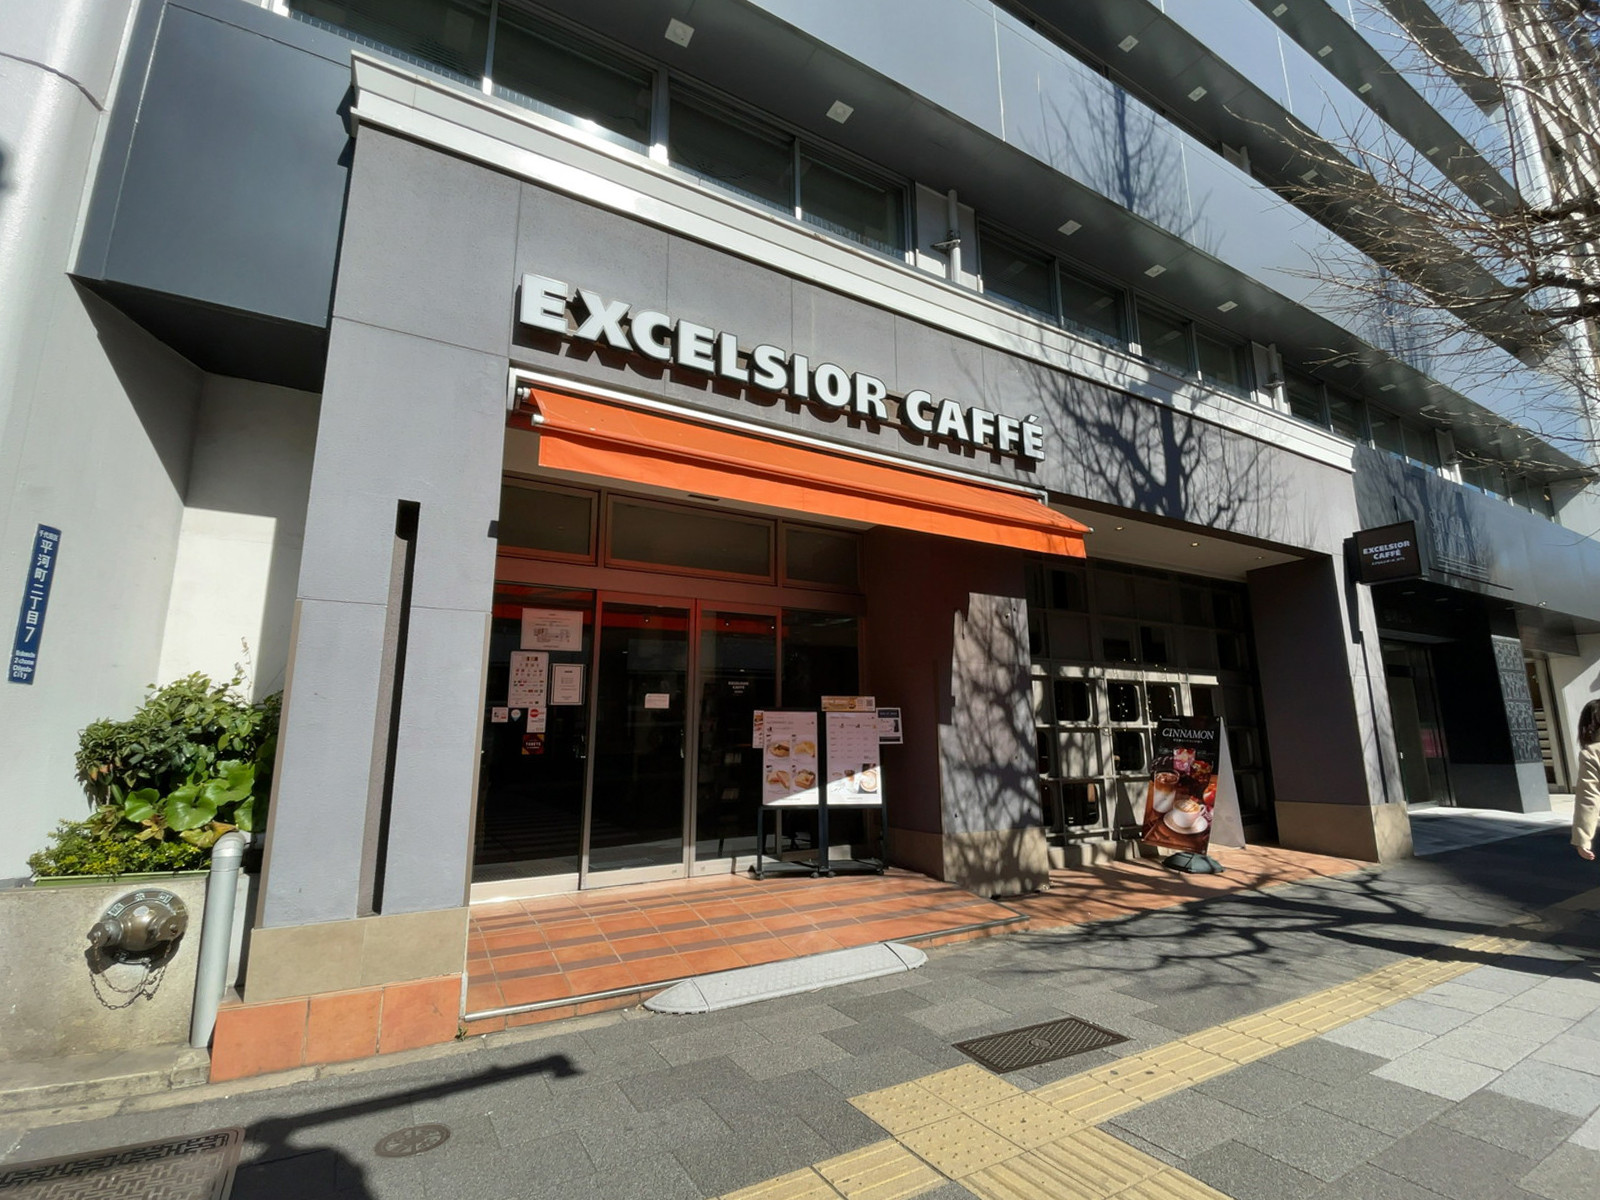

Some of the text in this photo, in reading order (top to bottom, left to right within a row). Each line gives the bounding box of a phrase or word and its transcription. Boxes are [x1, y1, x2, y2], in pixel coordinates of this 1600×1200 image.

[519, 272, 1046, 463] EXCELSIOR CAFFÉ
[1363, 540, 1411, 555] EXCELSIOR
[13, 671, 28, 680] City
[1162, 728, 1215, 740] CINNAMON
